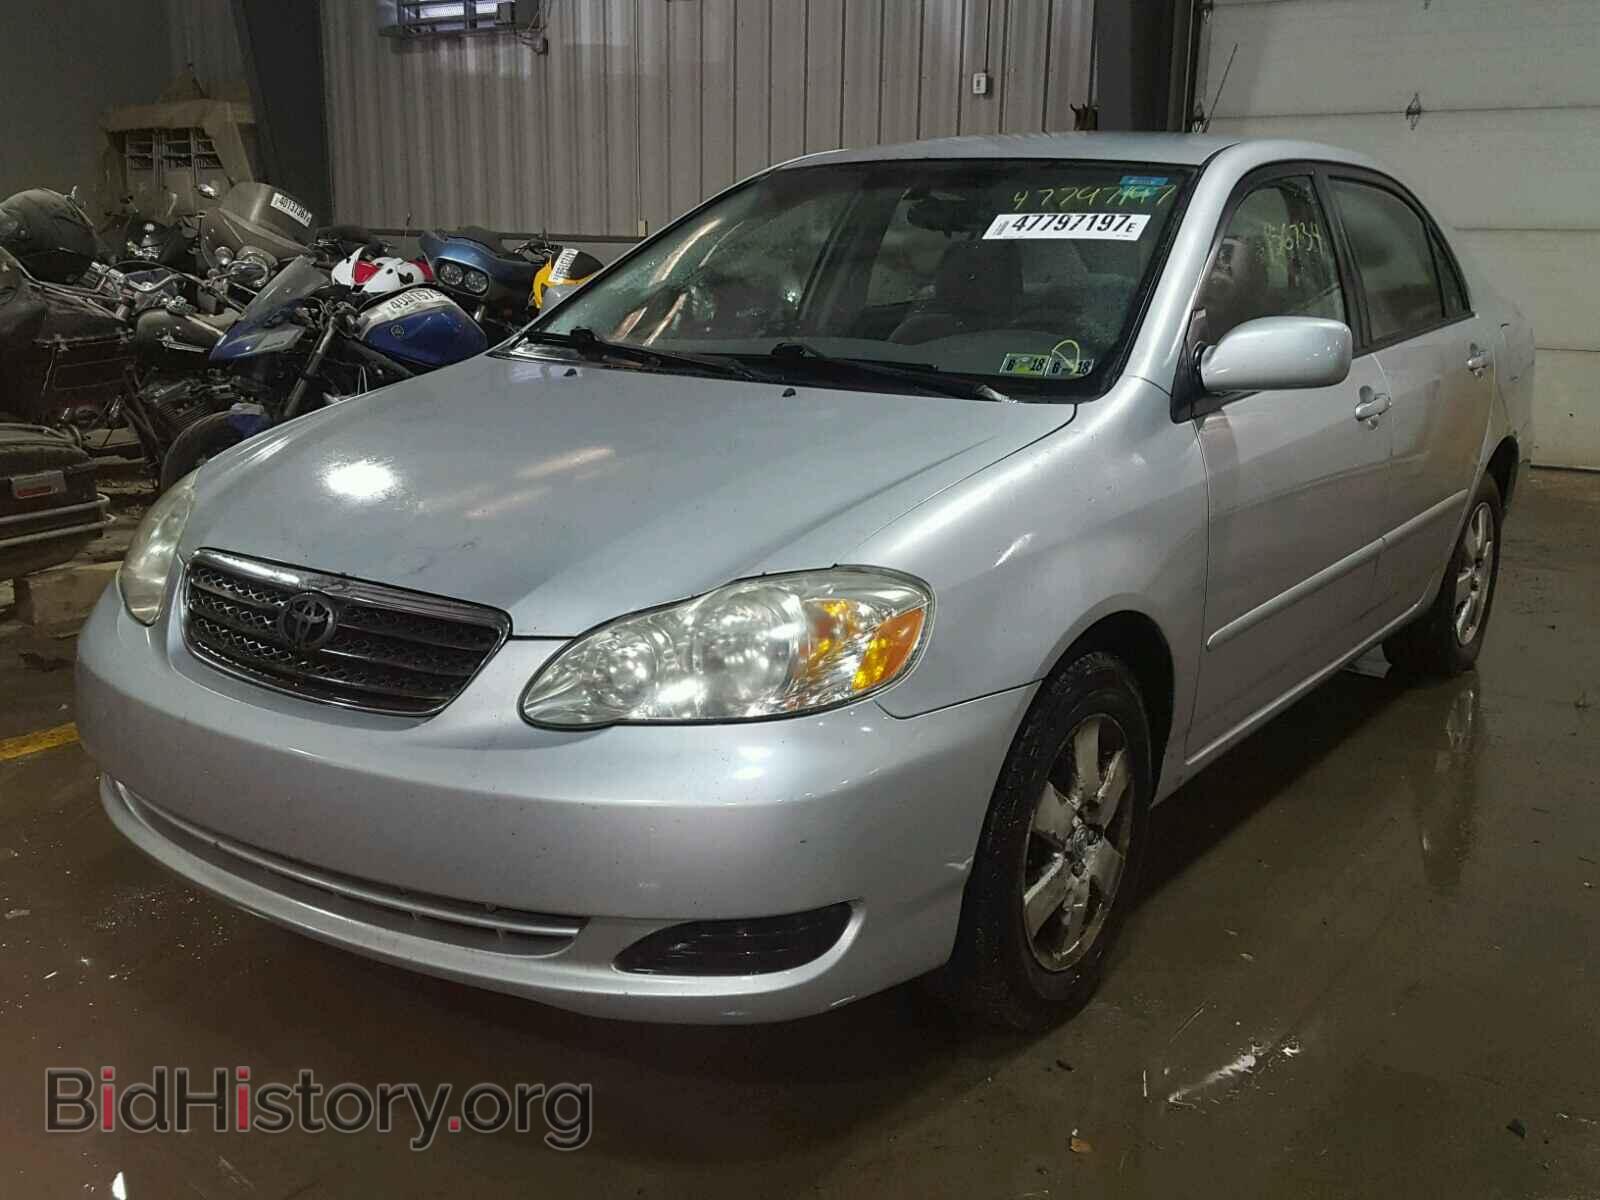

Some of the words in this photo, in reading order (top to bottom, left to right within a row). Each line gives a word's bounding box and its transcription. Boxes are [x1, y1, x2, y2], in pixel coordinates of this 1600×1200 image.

[1012, 214, 1137, 233] 47797197E
[1030, 358, 1045, 371] 18
[1052, 361, 1061, 374] 6
[1076, 360, 1090, 374] 18
